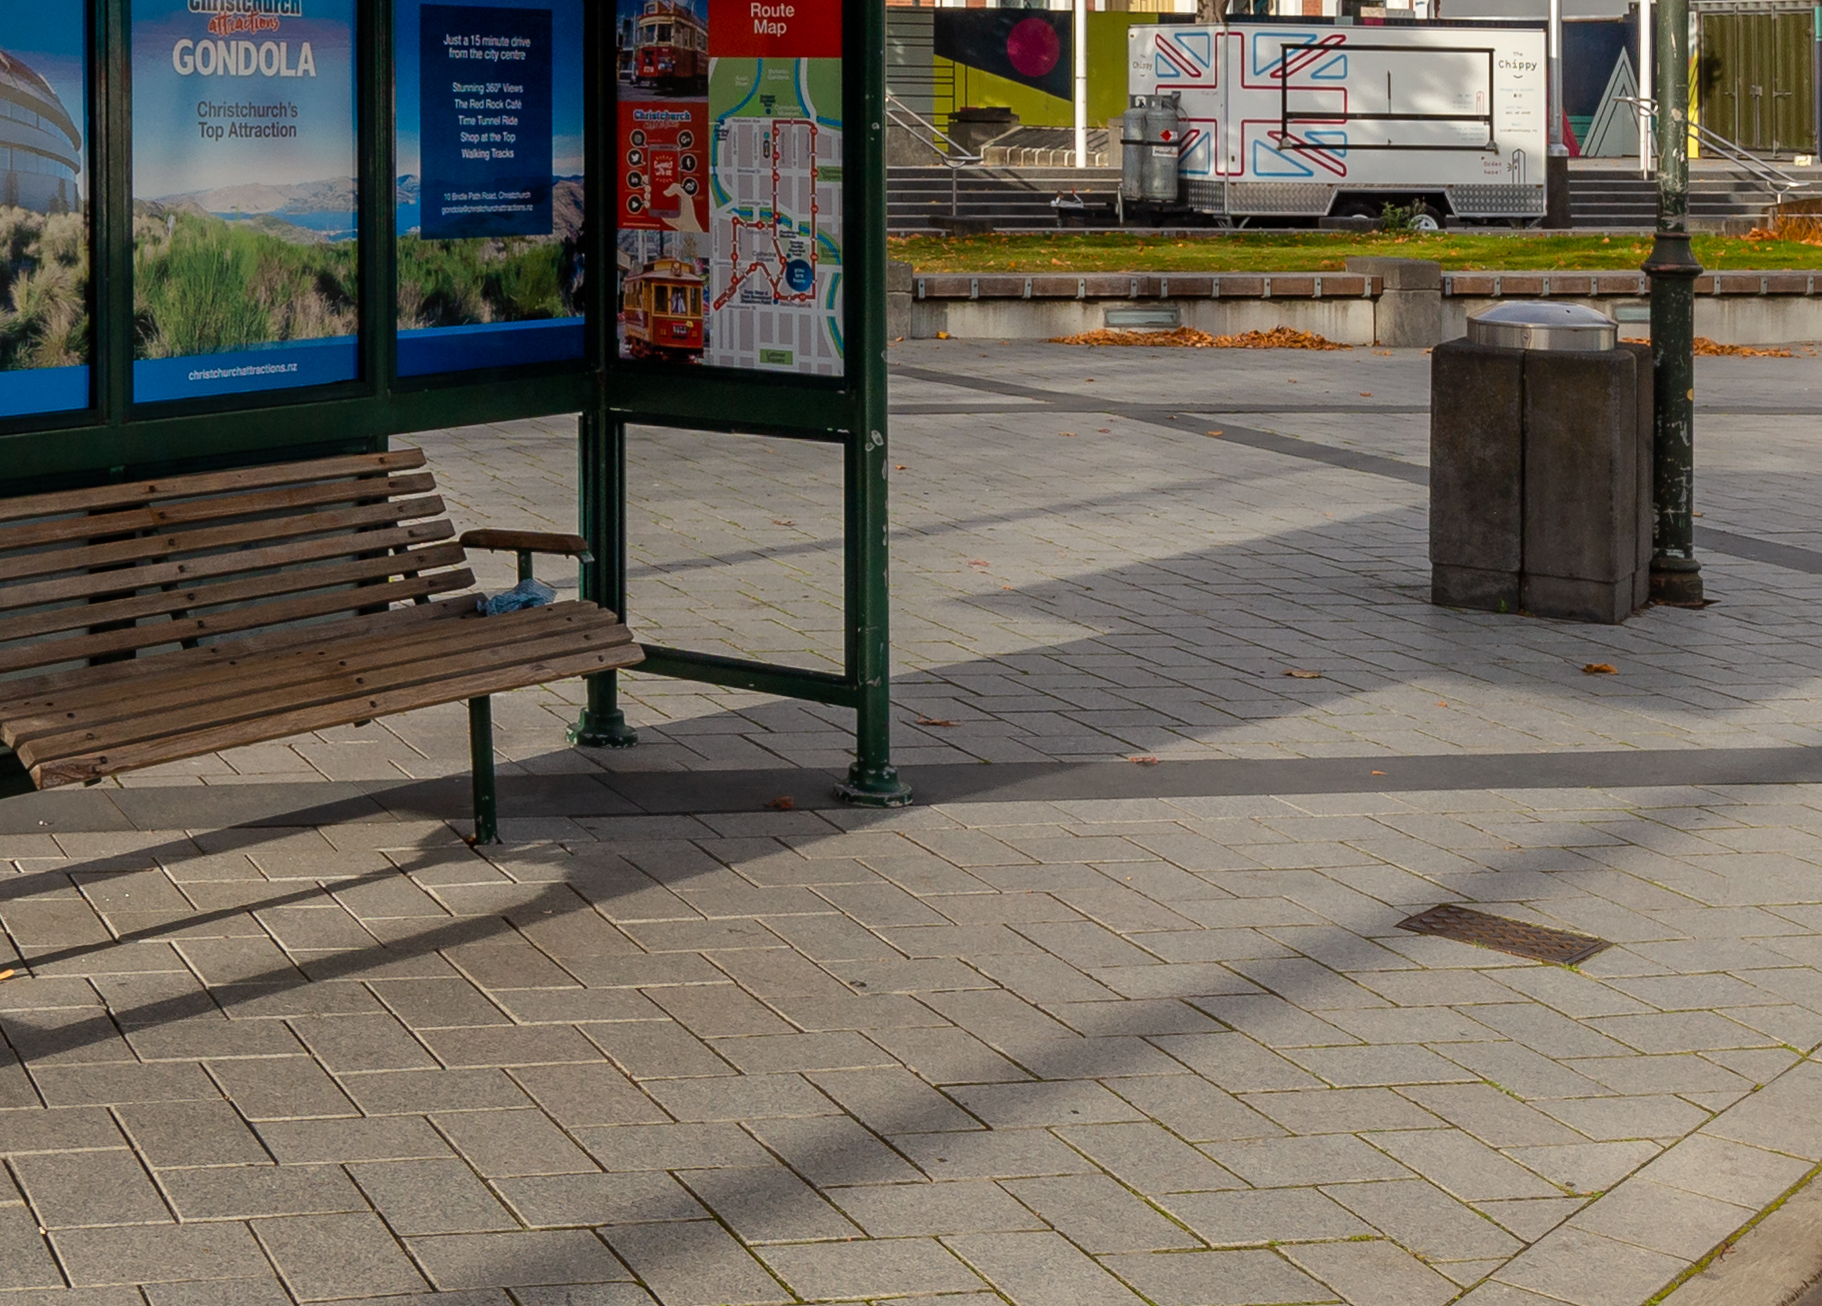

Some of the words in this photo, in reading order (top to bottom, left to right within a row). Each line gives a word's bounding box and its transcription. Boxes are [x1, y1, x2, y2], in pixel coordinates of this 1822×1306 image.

[750, 2, 796, 18] Route
[208, 11, 280, 37] attractions
[753, 19, 788, 37] Map
[443, 34, 462, 46] Just
[462, 36, 469, 46] a
[470, 34, 481, 46] 15
[482, 35, 510, 47] minute
[511, 34, 531, 48] drive
[173, 38, 316, 77] GONDOLA
[448, 47, 468, 59] from
[469, 47, 483, 60] the
[484, 48, 499, 62] city
[500, 49, 526, 61] centre
[1132, 60, 1153, 71] Chippy
[1498, 59, 1538, 71] Chippy
[452, 82, 485, 95] Stunning
[502, 83, 524, 94] Views
[197, 101, 298, 118] Christchurch's
[454, 98, 468, 109] The
[469, 98, 485, 109] Red
[485, 98, 504, 109] Rock
[458, 115, 476, 126] Time
[477, 115, 501, 126] Tunnel
[501, 115, 518, 126] Ride
[632, 109, 692, 122] Christchurch
[198, 122, 224, 141] Top
[227, 121, 297, 138] Attraction
[460, 131, 480, 144] Shop
[480, 132, 489, 142] at
[489, 132, 501, 142] the
[502, 131, 516, 143] Top
[461, 148, 491, 161] Walking
[491, 148, 515, 159] Tracks
[188, 362, 298, 381] christchurchattractions.nz
